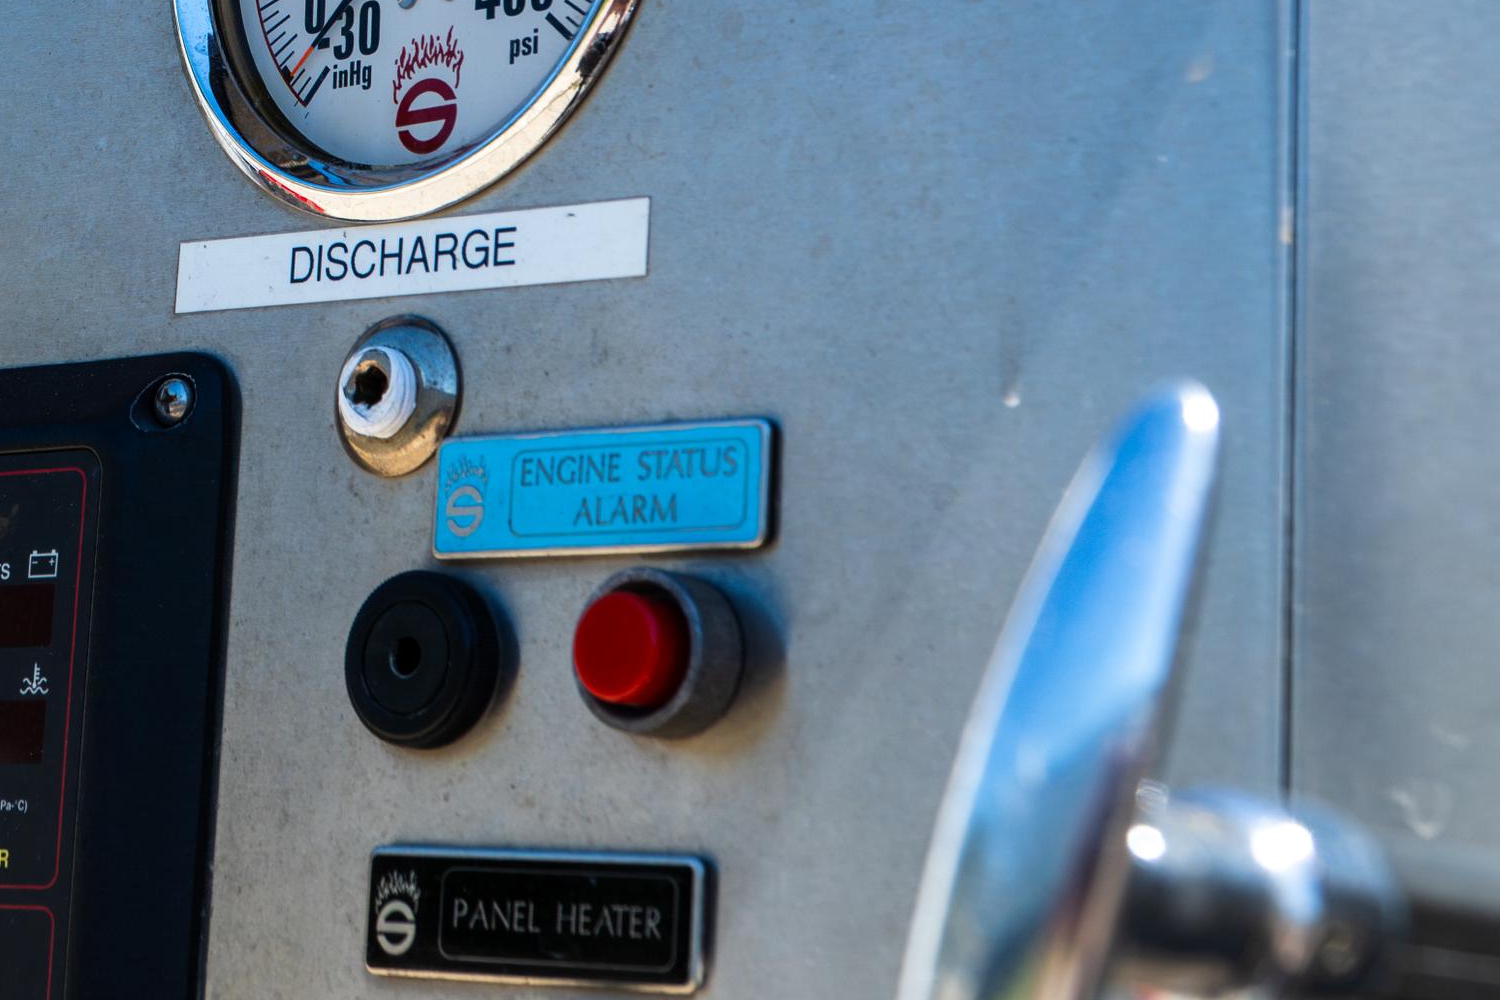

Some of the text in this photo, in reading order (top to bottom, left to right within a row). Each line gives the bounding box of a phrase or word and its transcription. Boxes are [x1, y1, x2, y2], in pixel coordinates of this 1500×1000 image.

[509, 29, 539, 64] psi
[333, 62, 373, 90] inHg
[290, 227, 517, 284] DISCHARGE
[520, 446, 738, 487] ENGINE STATUS
[573, 494, 678, 527] ALARM
[453, 899, 662, 940] PANEL HEATER
